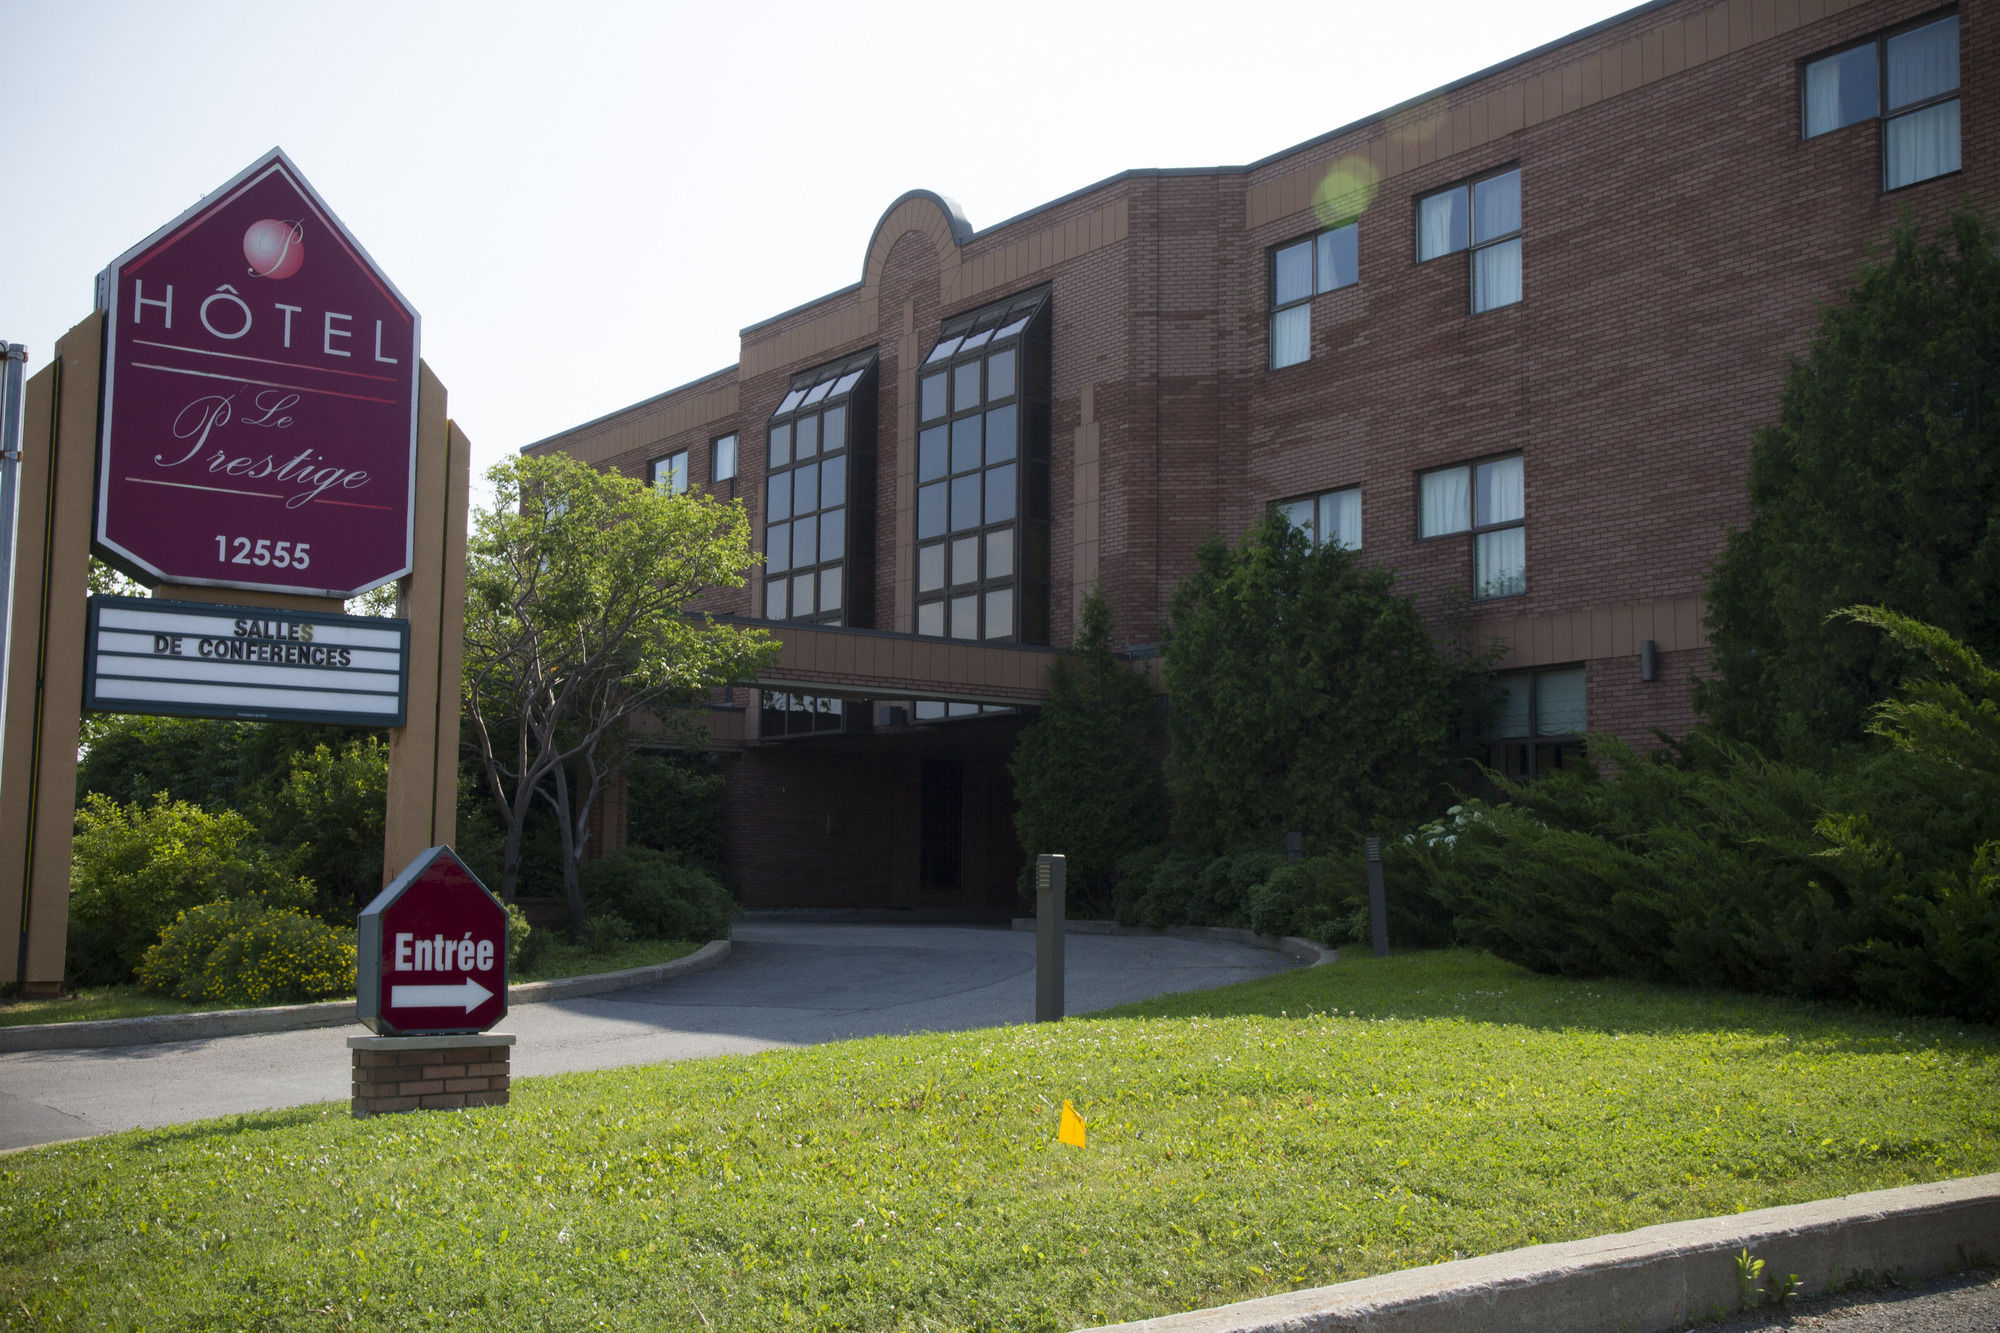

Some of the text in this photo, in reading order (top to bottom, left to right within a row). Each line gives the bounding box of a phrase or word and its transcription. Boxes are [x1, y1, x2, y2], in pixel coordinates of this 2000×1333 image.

[133, 279, 398, 364] HÔTEL
[241, 390, 300, 428] Le
[154, 394, 371, 509] Prestige
[215, 534, 311, 570] 12555
[234, 618, 314, 642] SALLES
[154, 635, 352, 666] DE CONFERENCES
[395, 932, 494, 972] Entrée
